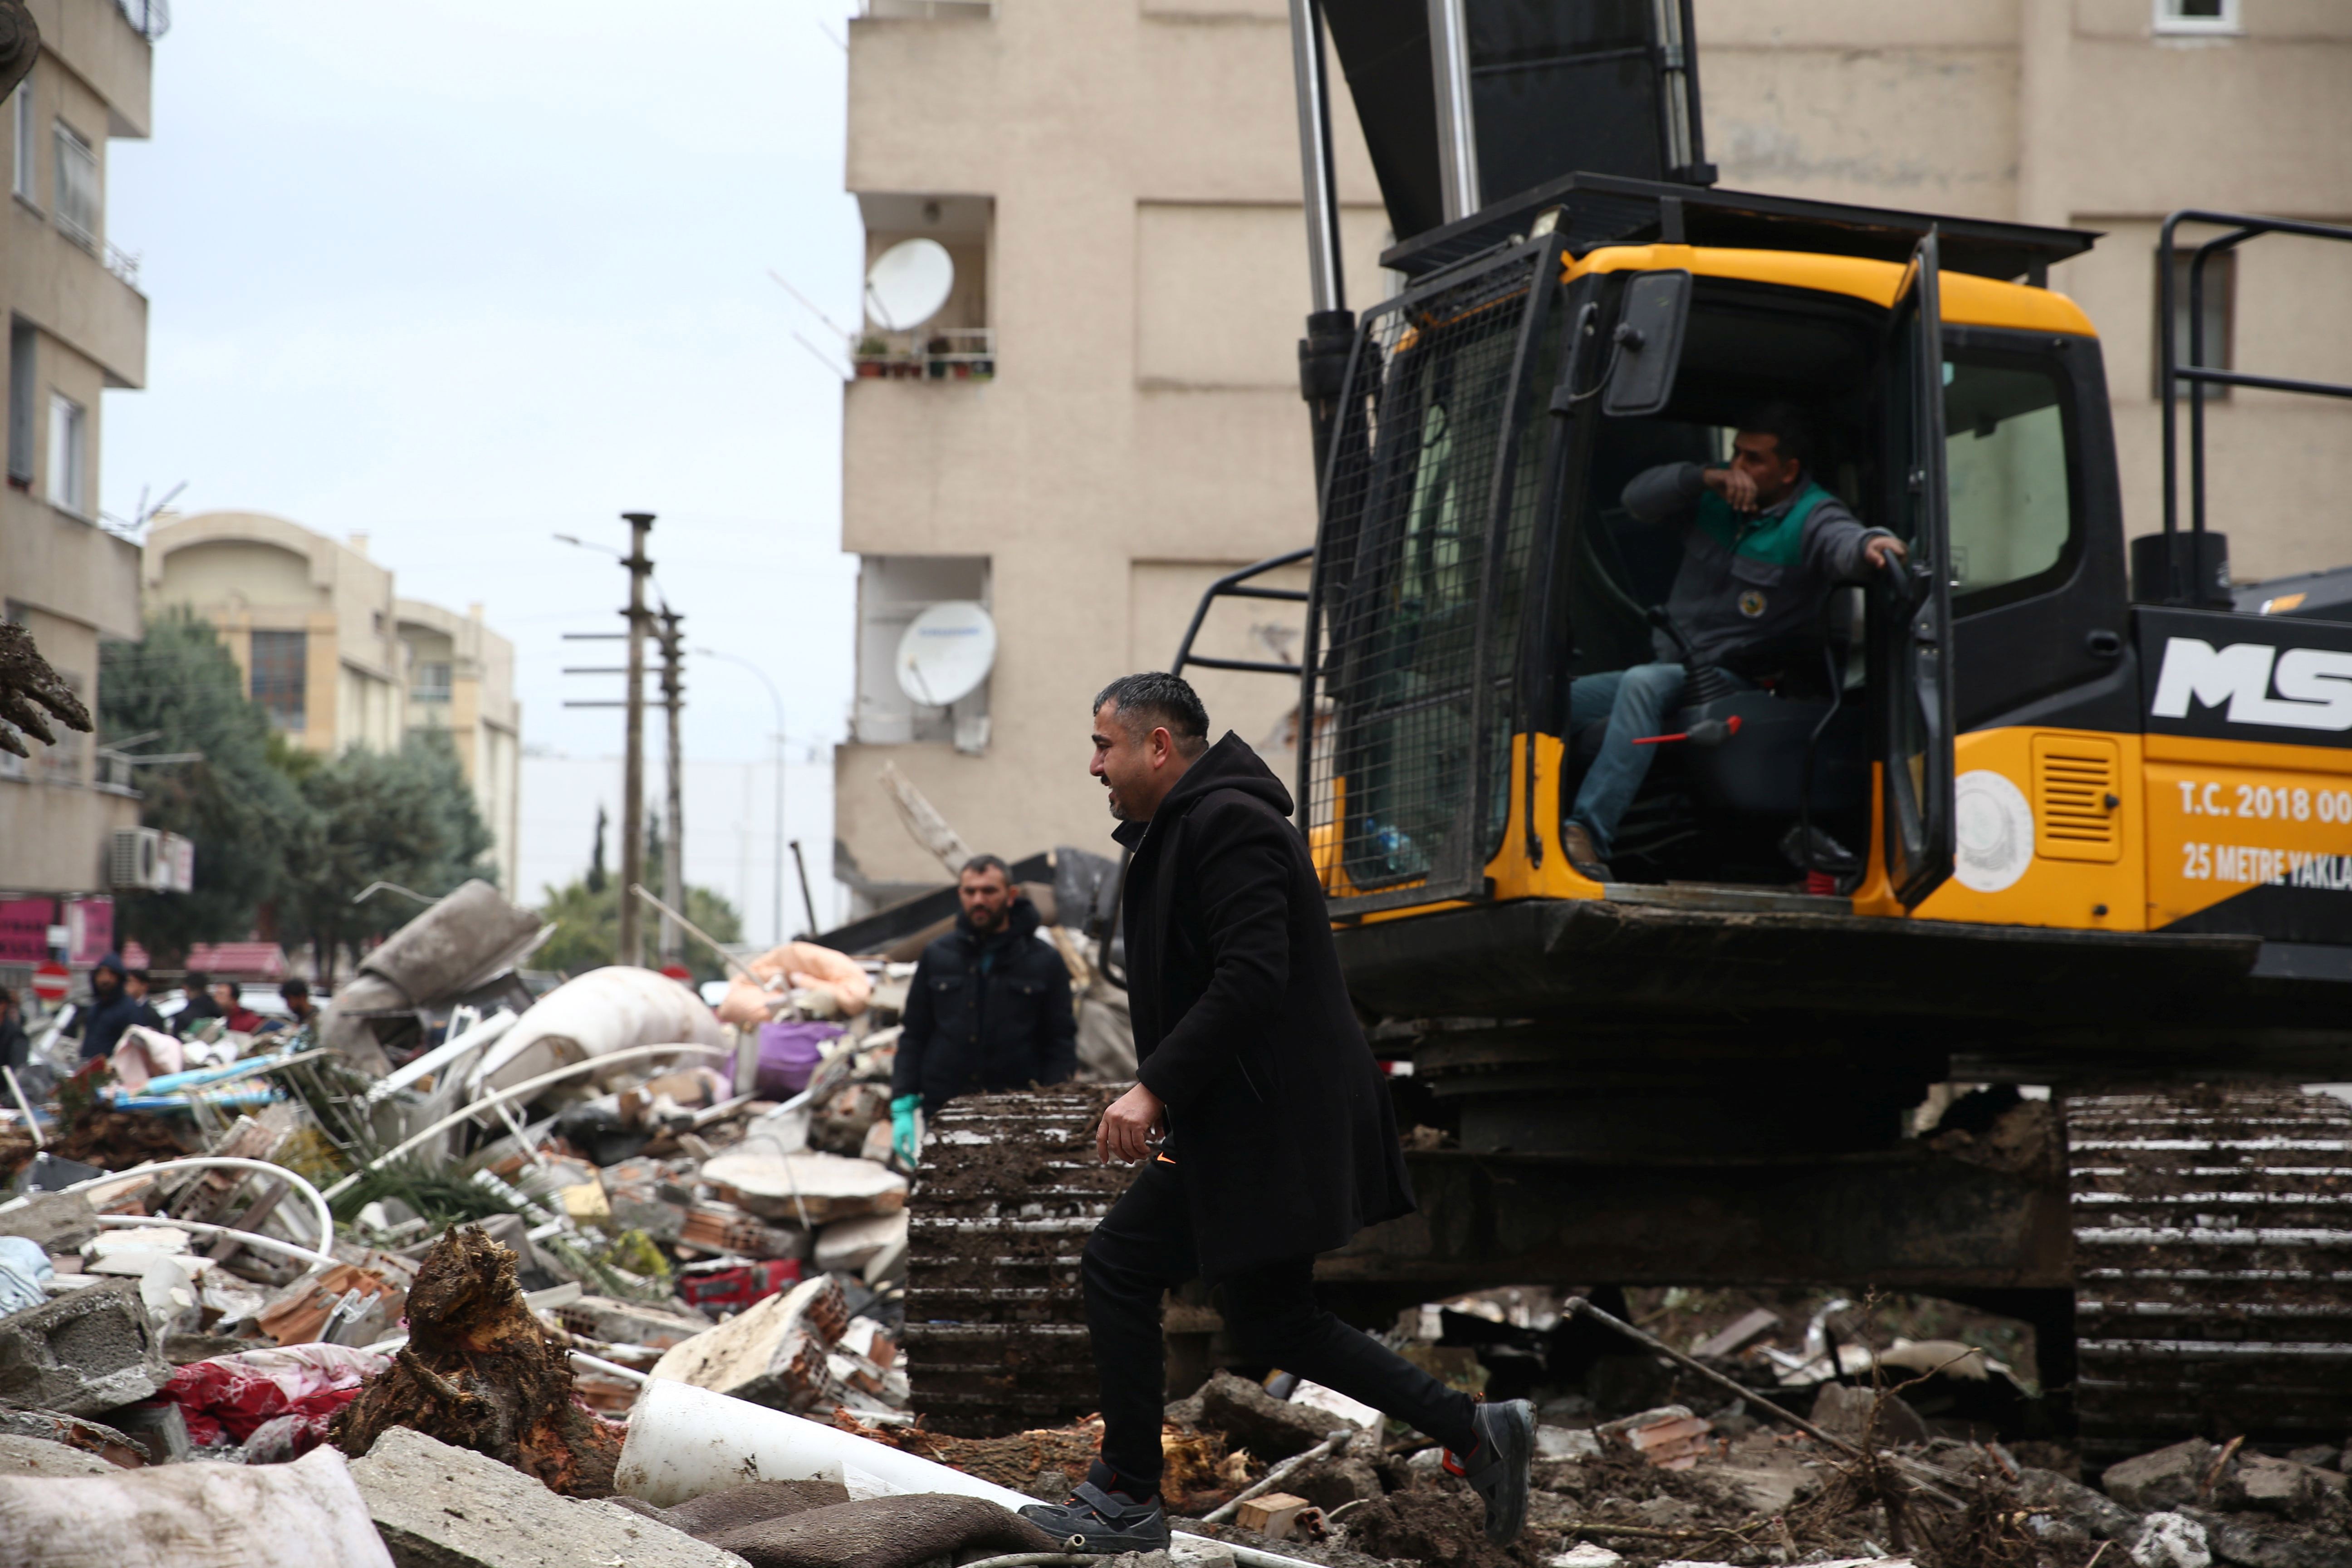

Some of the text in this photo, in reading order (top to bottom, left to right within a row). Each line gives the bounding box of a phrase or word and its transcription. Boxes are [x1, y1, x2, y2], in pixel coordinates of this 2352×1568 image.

[2179, 780, 2352, 824] T.C. 2018 00
[2183, 842, 2352, 892] 25 METRE YAKLA
